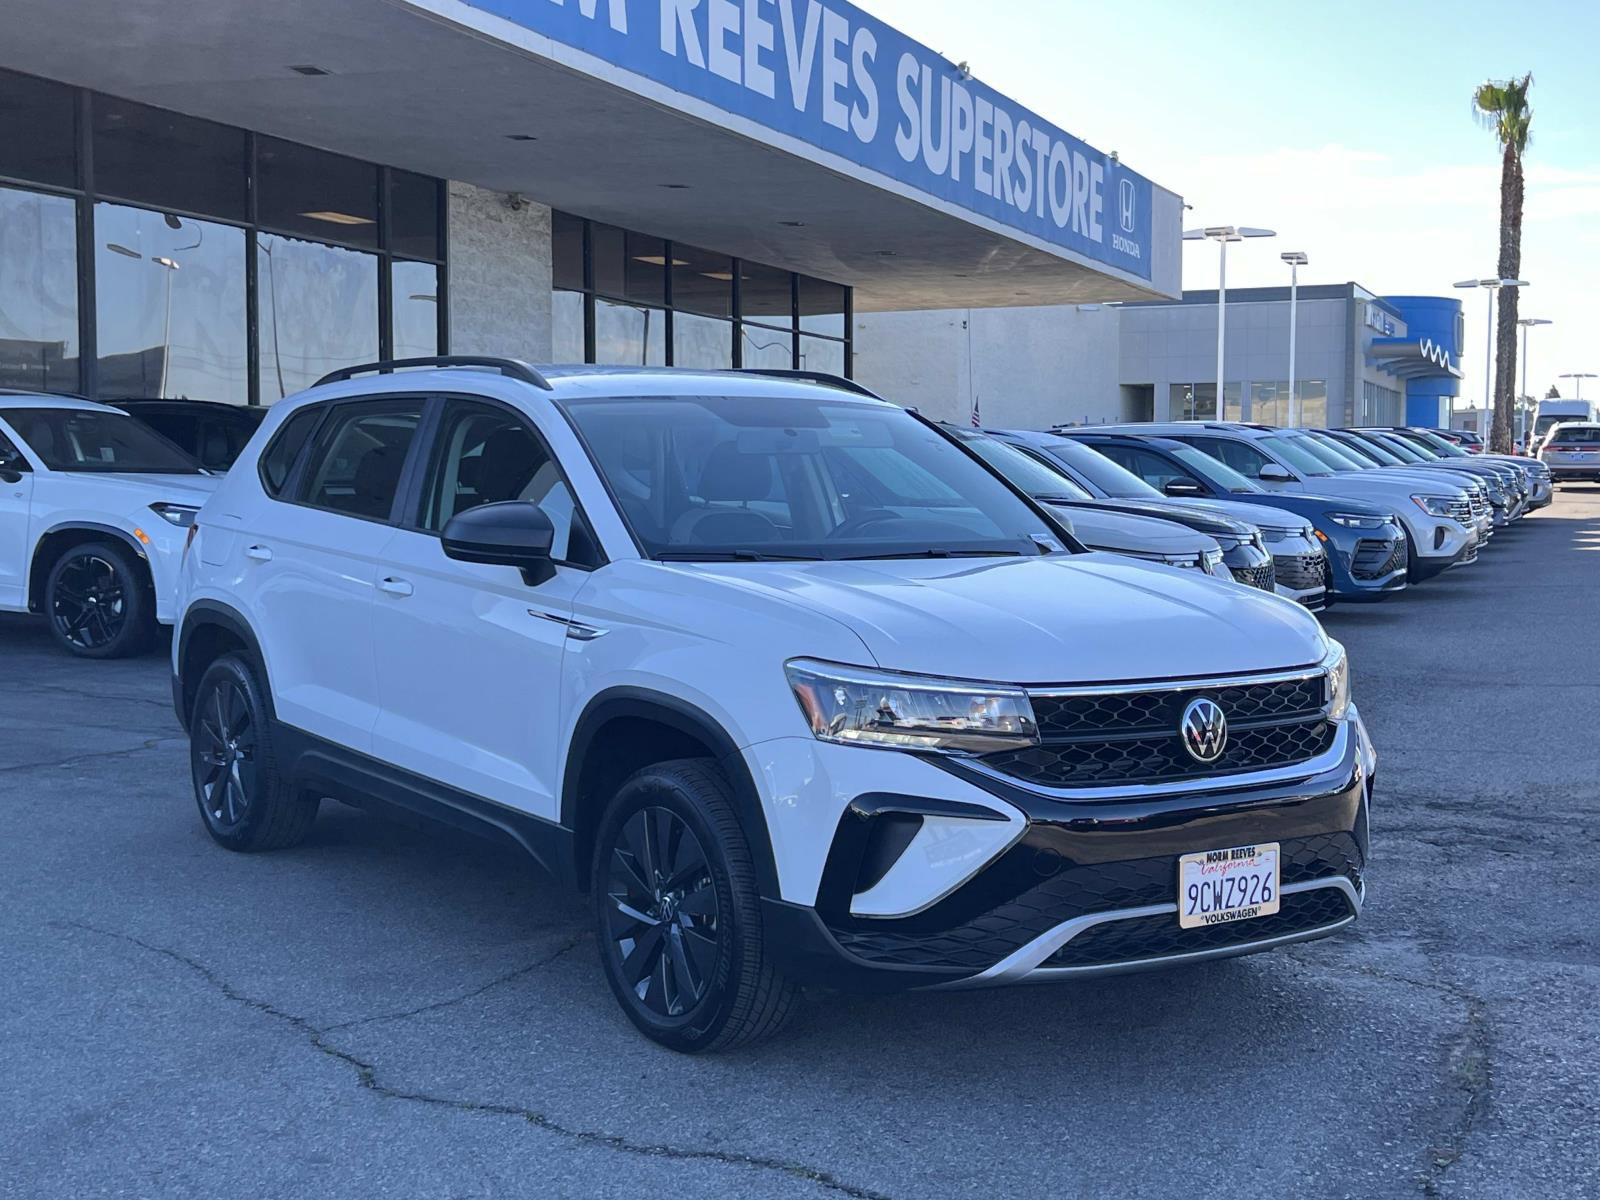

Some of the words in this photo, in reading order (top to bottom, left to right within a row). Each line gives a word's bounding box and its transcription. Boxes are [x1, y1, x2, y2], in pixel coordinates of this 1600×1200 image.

[895, 52, 1103, 243] SUPERSTORE
[1112, 233, 1140, 259] HONDA
[1206, 850, 1229, 863] NORM
[1231, 847, 1256, 859] REEVES
[1188, 872, 1272, 915] 9CWZ926
[1204, 907, 1258, 924] VOLKSWAGEN
